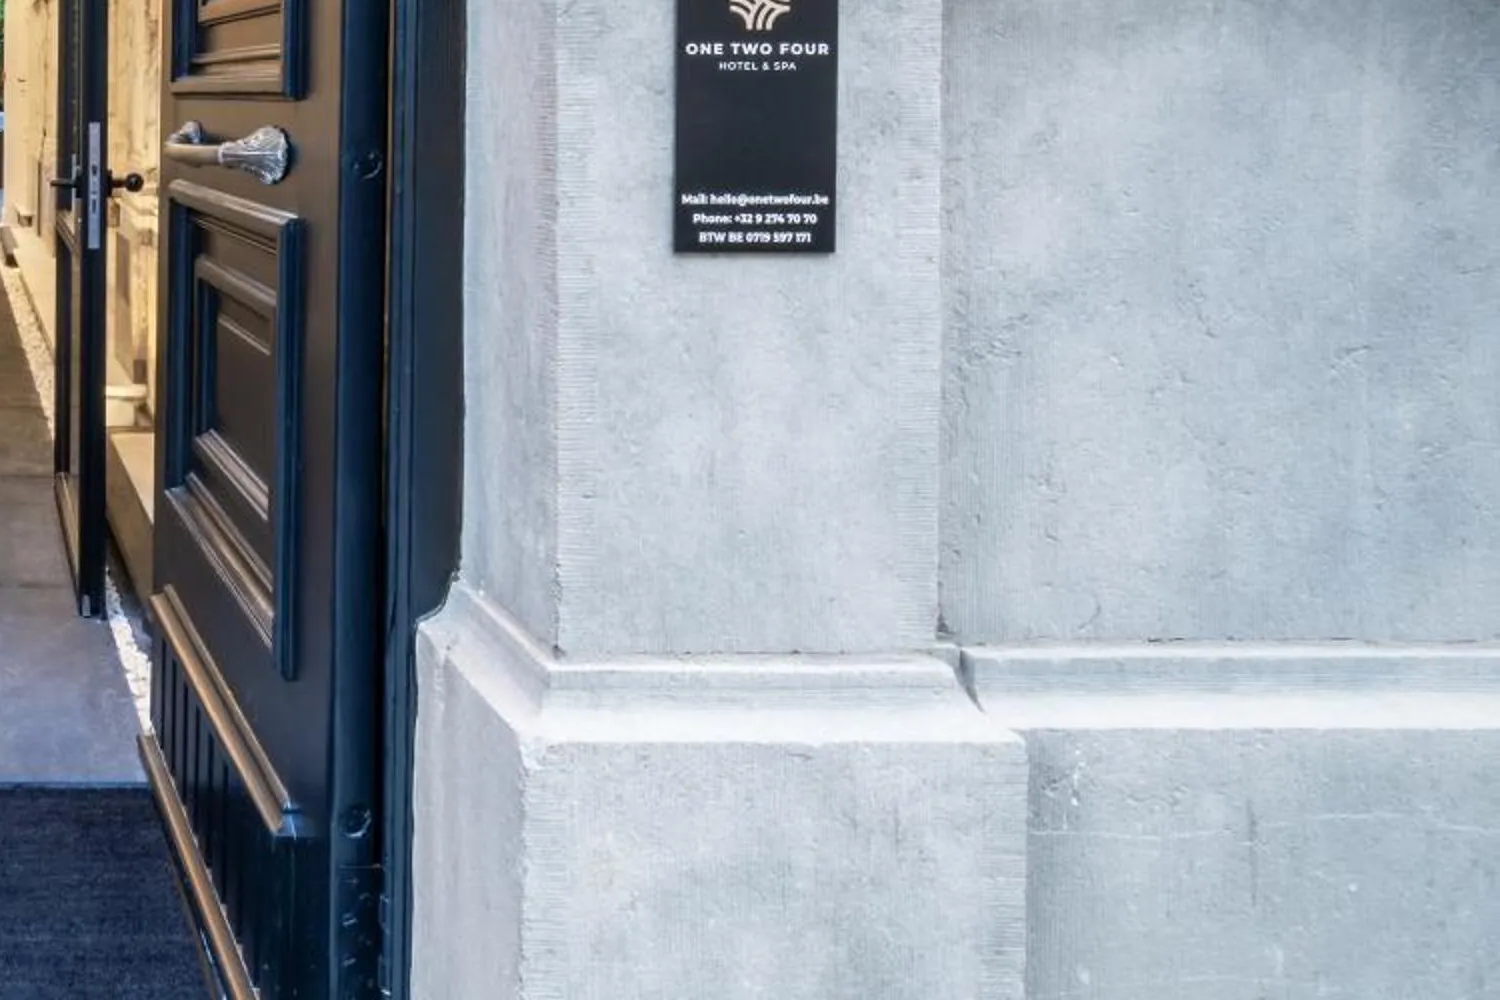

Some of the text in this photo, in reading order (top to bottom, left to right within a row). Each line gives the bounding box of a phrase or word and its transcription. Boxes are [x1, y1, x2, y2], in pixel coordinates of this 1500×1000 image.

[685, 43, 829, 55] ONE TWO FOUR
[719, 61, 797, 71] HOTEL & SPA
[681, 194, 708, 204] Mail:
[693, 213, 732, 224] Phone:
[734, 213, 753, 224] +32
[755, 213, 762, 224] 9
[699, 232, 726, 243] BTW
[728, 232, 744, 243] BE
